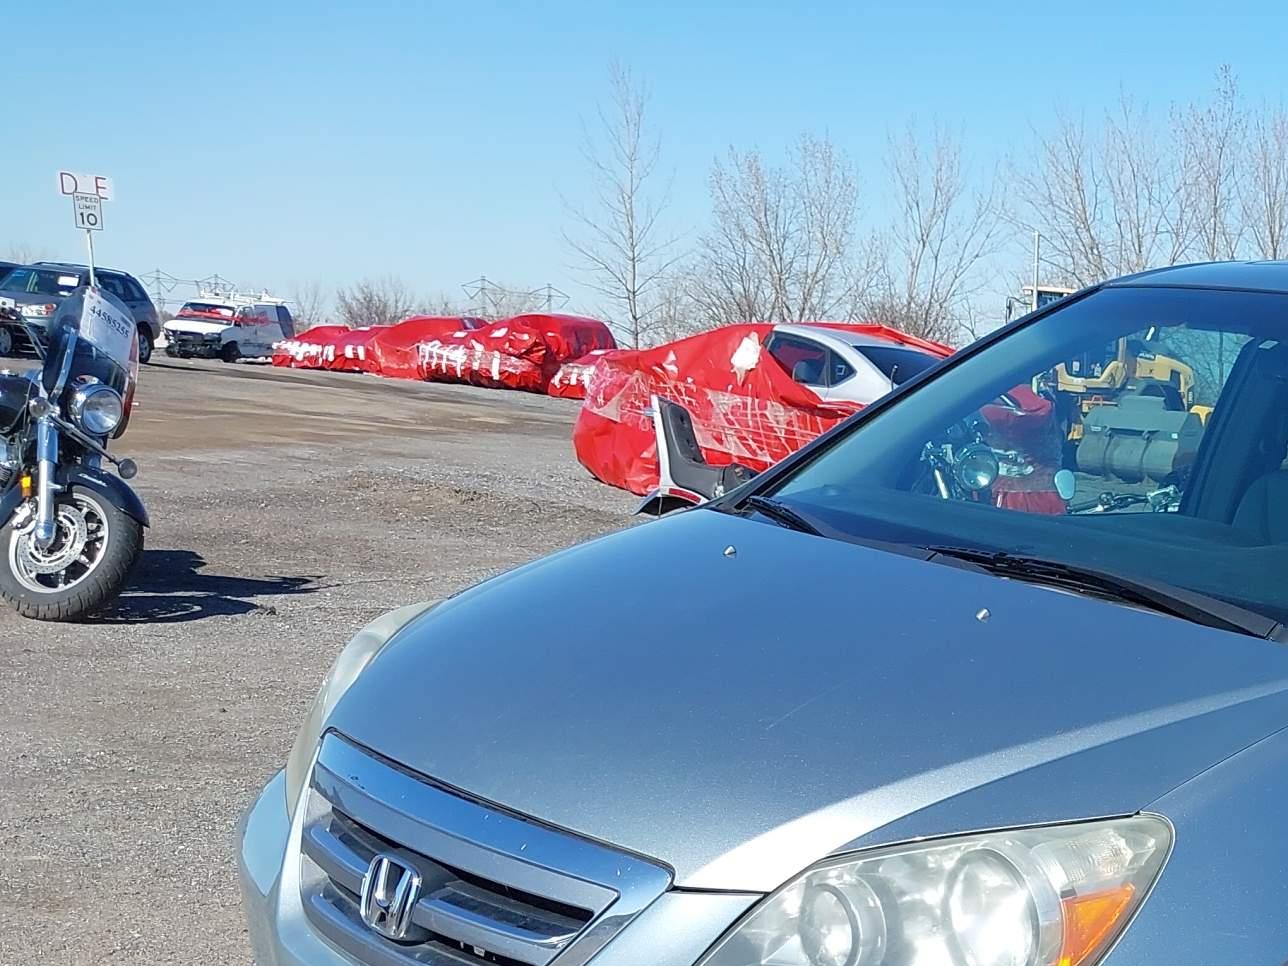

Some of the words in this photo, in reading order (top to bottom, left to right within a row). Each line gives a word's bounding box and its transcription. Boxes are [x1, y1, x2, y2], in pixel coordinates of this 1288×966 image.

[60, 172, 77, 195] D
[95, 176, 108, 200] E
[75, 195, 98, 203] SPEED
[80, 212, 97, 226] 10
